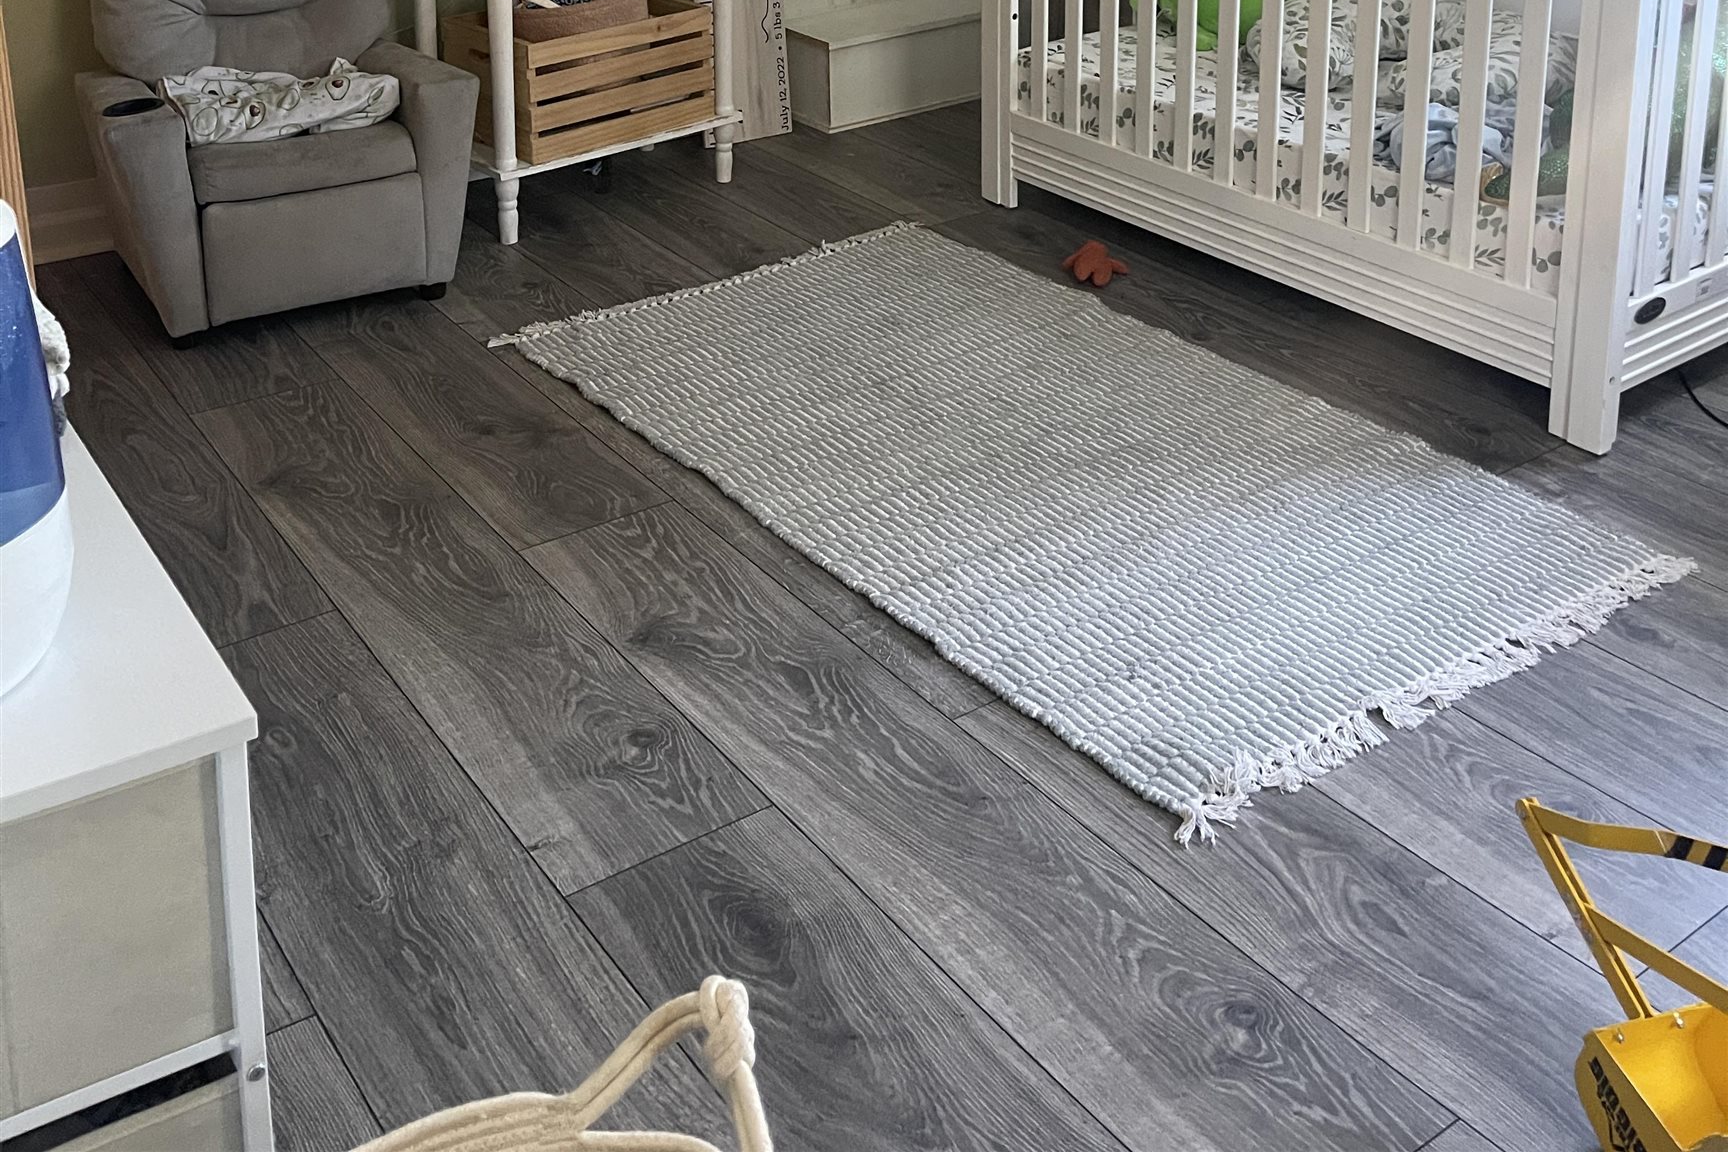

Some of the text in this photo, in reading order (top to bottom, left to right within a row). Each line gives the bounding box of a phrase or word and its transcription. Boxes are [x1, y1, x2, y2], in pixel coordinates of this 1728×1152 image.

[772, 1, 781, 9] 3
[773, 12, 782, 30] lbs
[775, 32, 783, 40] 5
[776, 57, 786, 86] 2022
[780, 105, 790, 131] July
